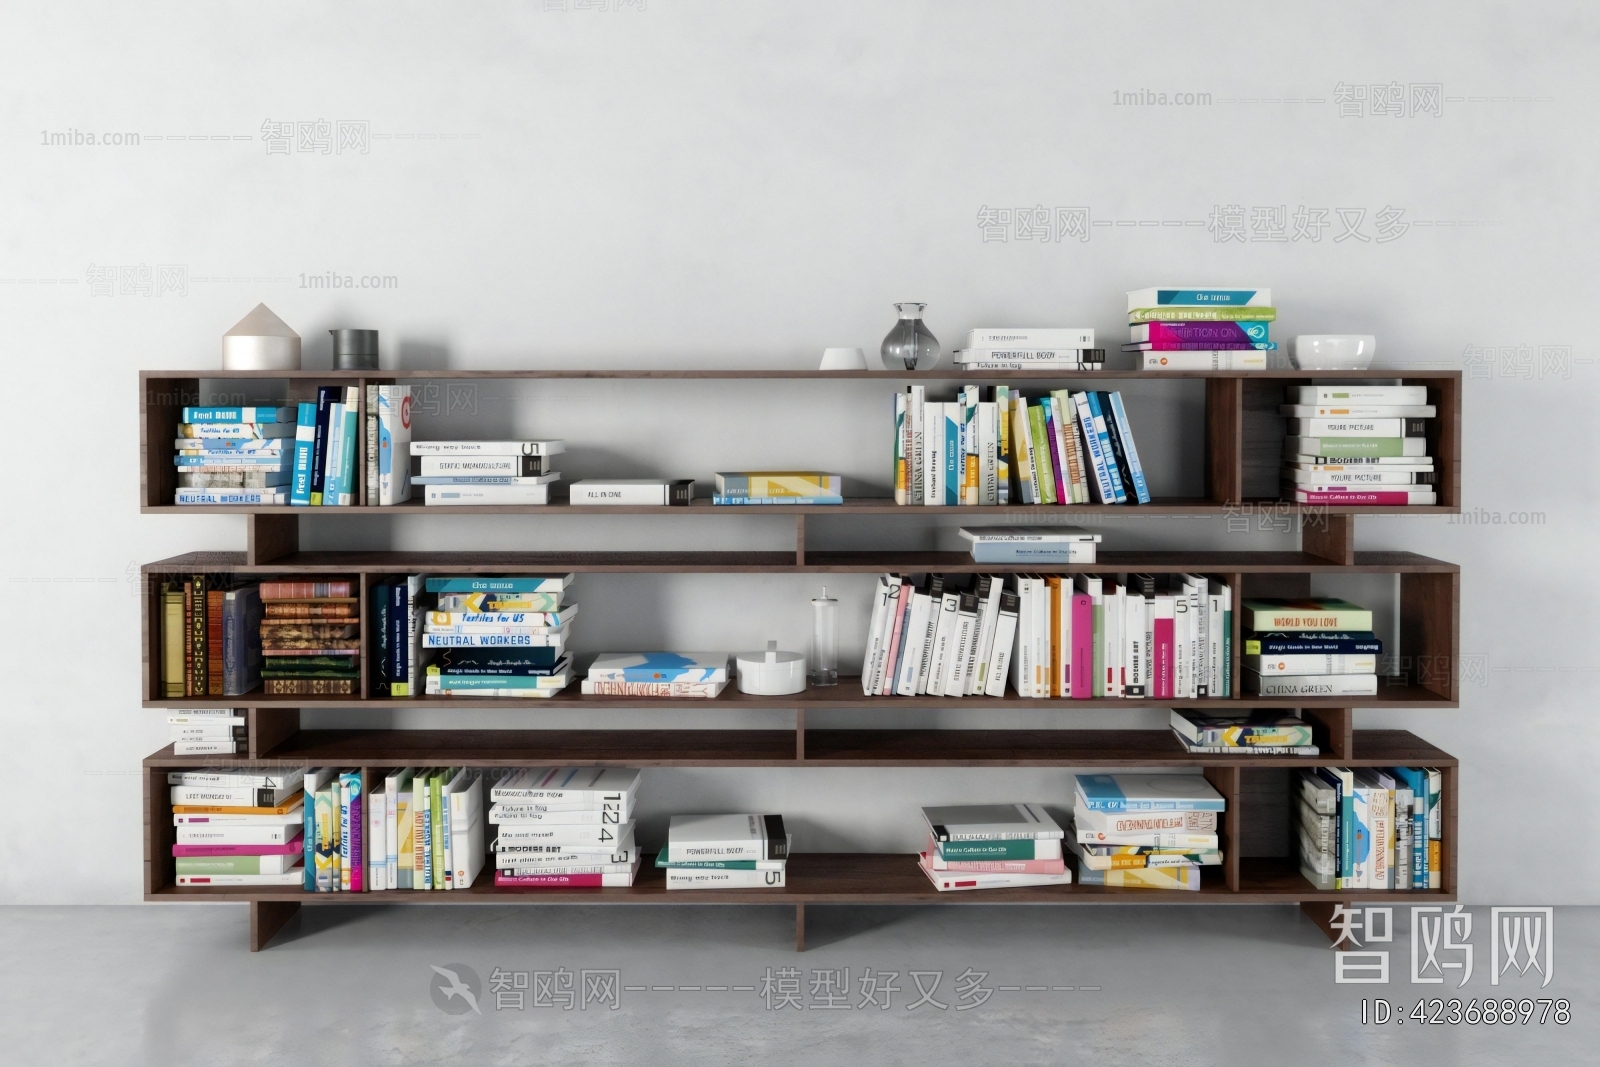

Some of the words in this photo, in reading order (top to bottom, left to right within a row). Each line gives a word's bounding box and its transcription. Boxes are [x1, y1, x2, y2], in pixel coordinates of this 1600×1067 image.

[944, 598, 958, 613] 3
[1176, 599, 1188, 614] 5
[462, 613, 494, 623] Textiles
[496, 613, 510, 623] for
[512, 613, 525, 623] US
[1302, 618, 1319, 627] YOU
[428, 635, 476, 646] NEUTRAL
[479, 635, 531, 646] WORKERS
[1265, 685, 1299, 694] CHINA
[1300, 685, 1333, 694] GREEN
[261, 776, 277, 790] 4
[598, 827, 614, 843] 4
[610, 850, 629, 864] 3
[765, 871, 781, 886] 5
